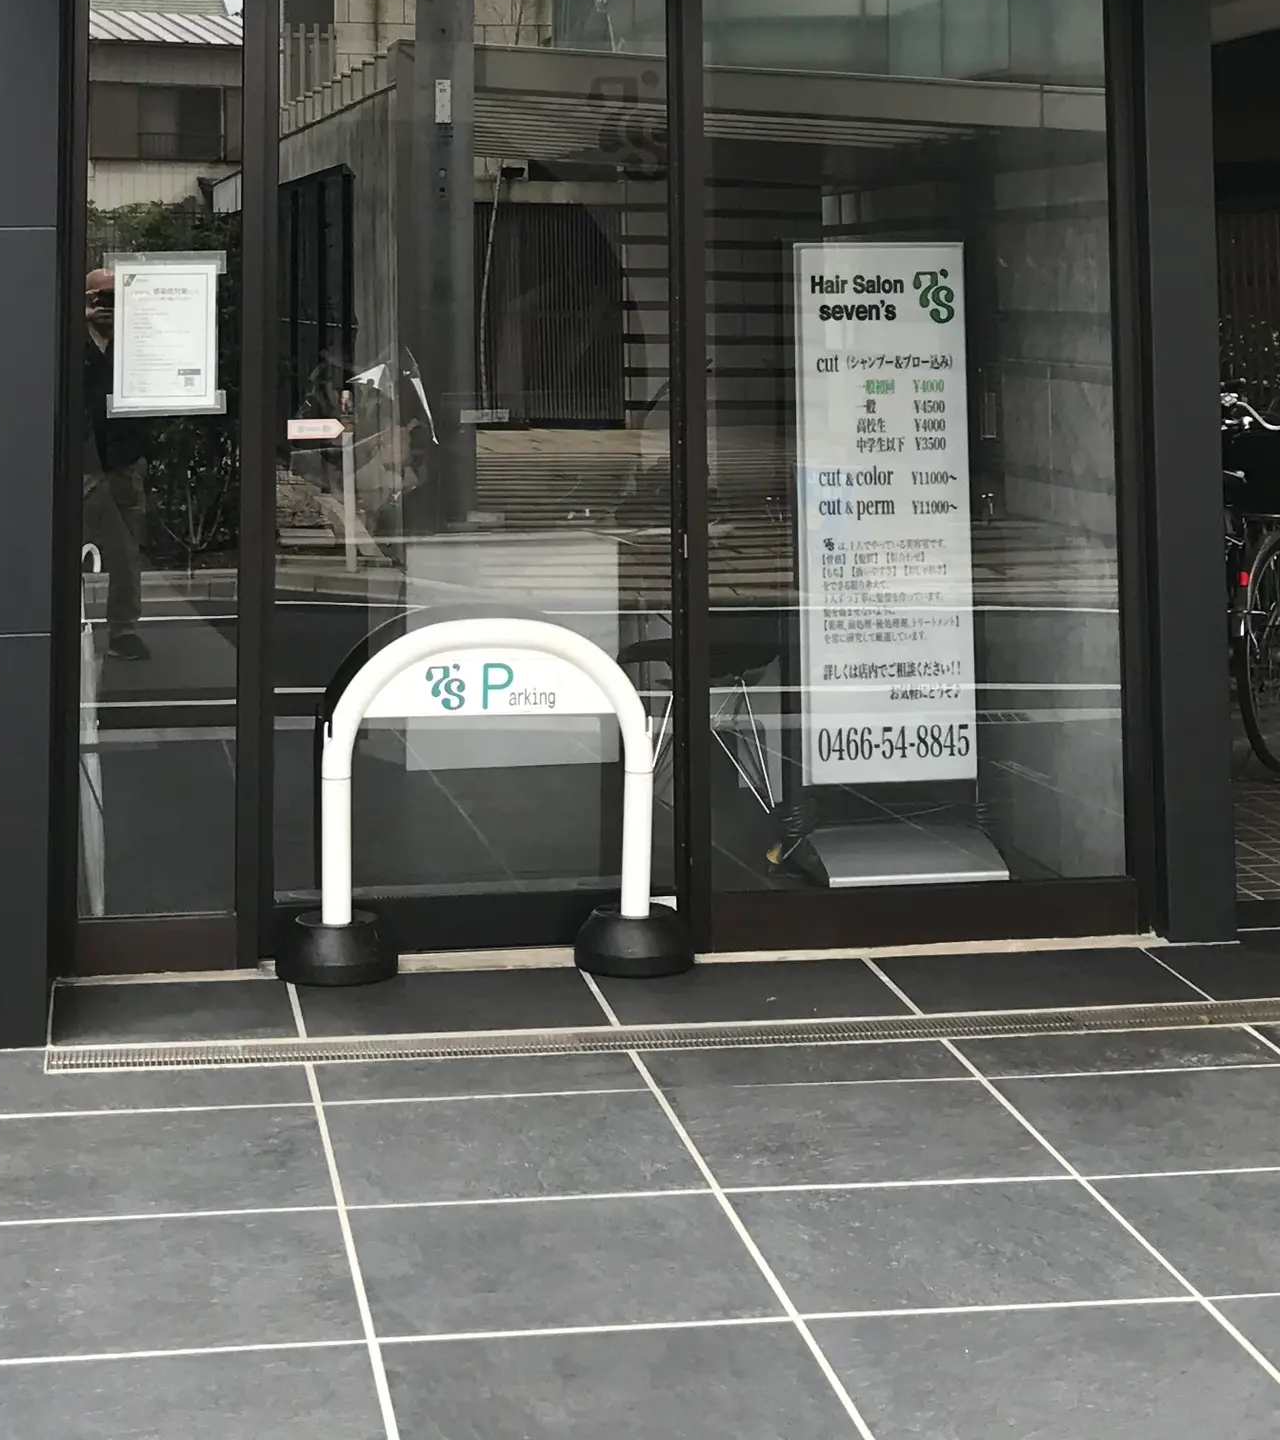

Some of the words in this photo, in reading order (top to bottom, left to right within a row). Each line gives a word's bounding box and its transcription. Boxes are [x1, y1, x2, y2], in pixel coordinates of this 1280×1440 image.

[810, 275, 848, 294] Hair
[852, 275, 904, 294] Salon
[819, 300, 897, 321] seven's
[816, 354, 839, 372] cut
[913, 379, 945, 393] ¥4000
[856, 399, 876, 414] 一般
[914, 400, 945, 414] ¥4500
[856, 418, 887, 433] 高校生
[914, 418, 946, 432] ¥4000
[856, 436, 905, 453] 中学生以下
[915, 437, 946, 451] ¥3500
[819, 468, 842, 487] cut
[846, 474, 854, 486] &
[856, 465, 894, 486] color
[819, 498, 842, 516] cut
[846, 503, 854, 515] &
[856, 499, 895, 520] perm
[482, 662, 556, 709] Parking
[818, 723, 970, 762] 0466-54-8845
